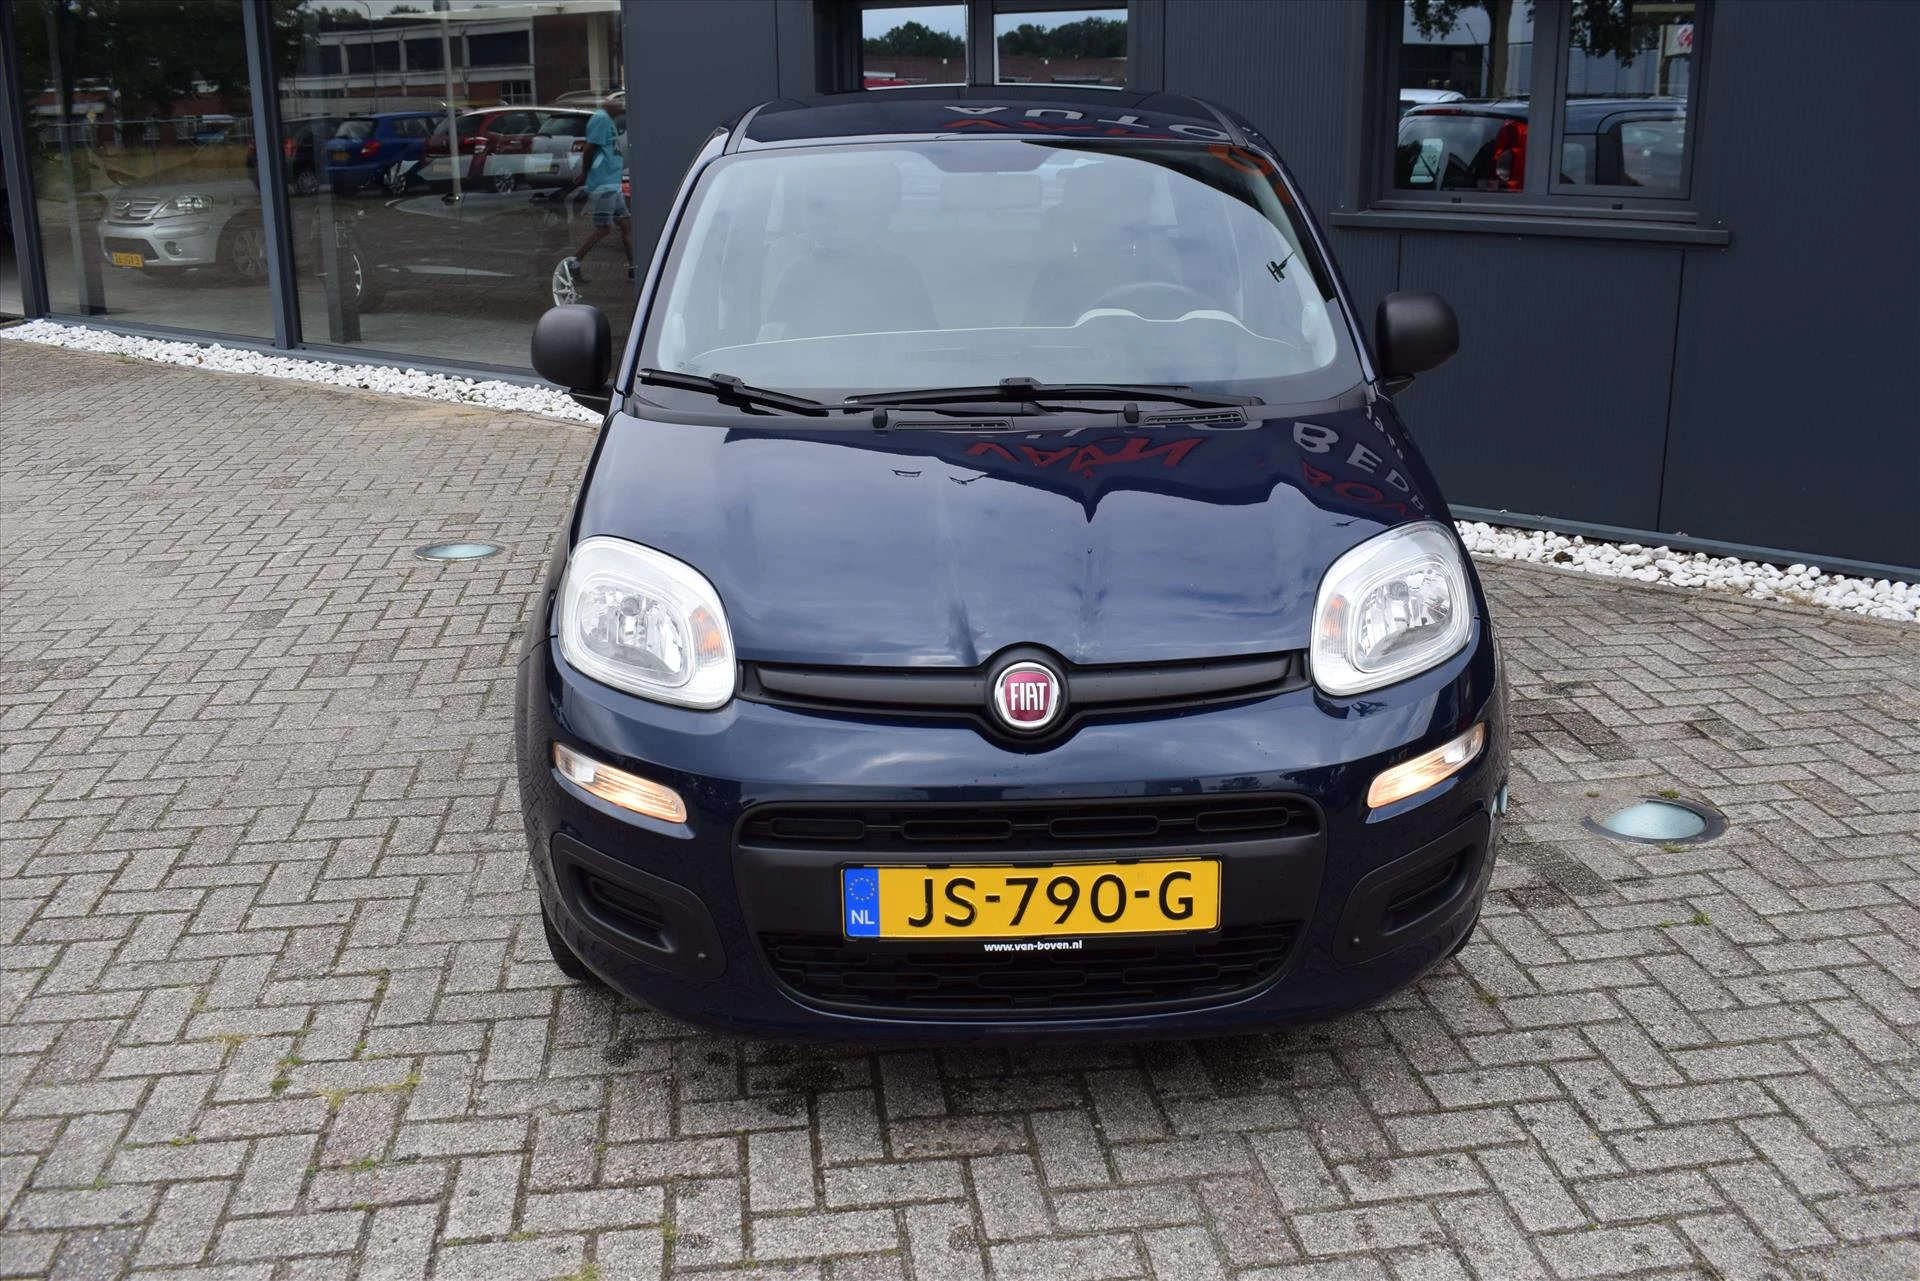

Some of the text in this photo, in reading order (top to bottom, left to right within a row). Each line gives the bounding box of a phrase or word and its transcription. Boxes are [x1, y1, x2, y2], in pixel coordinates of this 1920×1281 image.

[1010, 682, 1048, 711] FIAT
[908, 871, 1194, 928] JS-790-G
[851, 909, 875, 925] NL
[984, 940, 1082, 952] www.van-boven.nl
